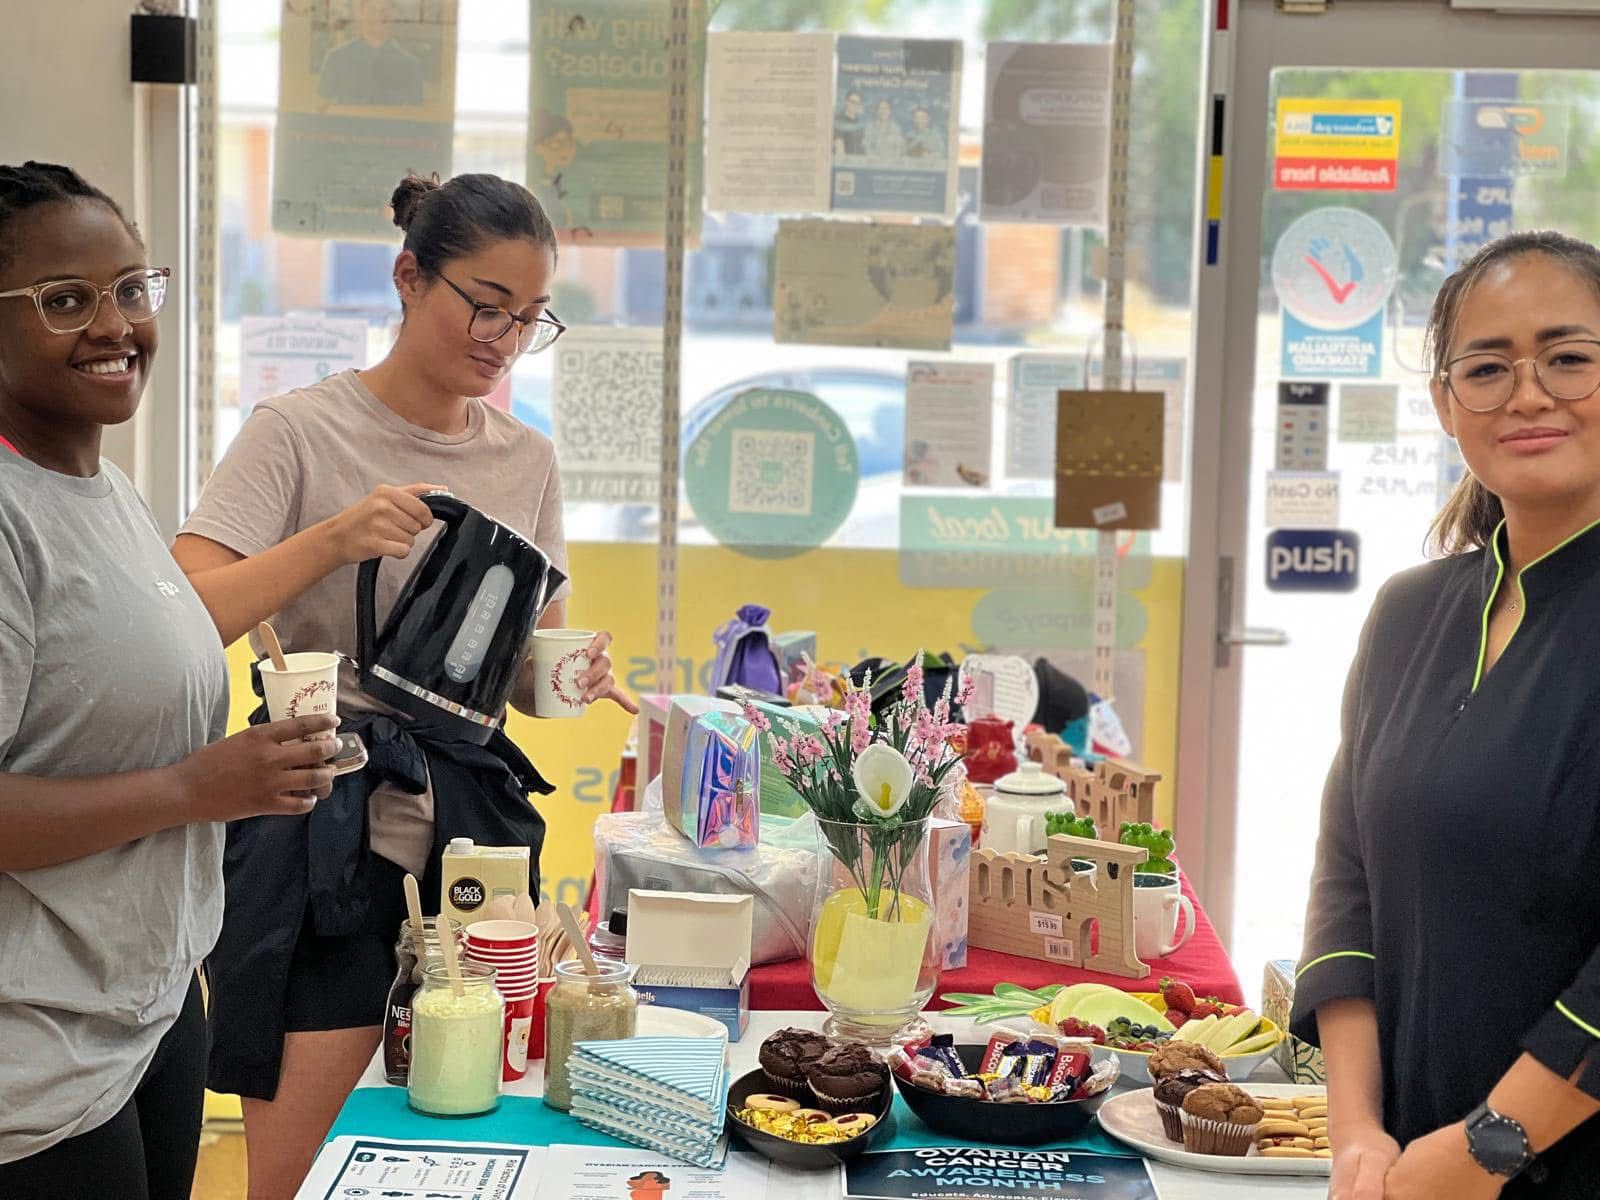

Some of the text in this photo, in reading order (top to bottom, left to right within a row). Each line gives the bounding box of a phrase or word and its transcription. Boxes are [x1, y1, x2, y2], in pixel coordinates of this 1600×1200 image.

[1270, 539, 1355, 580] push
[454, 886, 480, 894] BLACK
[915, 1147, 1070, 1164] OVARIAN
[924, 1157, 1065, 1172] CANCER
[886, 1167, 1107, 1184] AWARENESS
[935, 1177, 1062, 1191] MONTH
